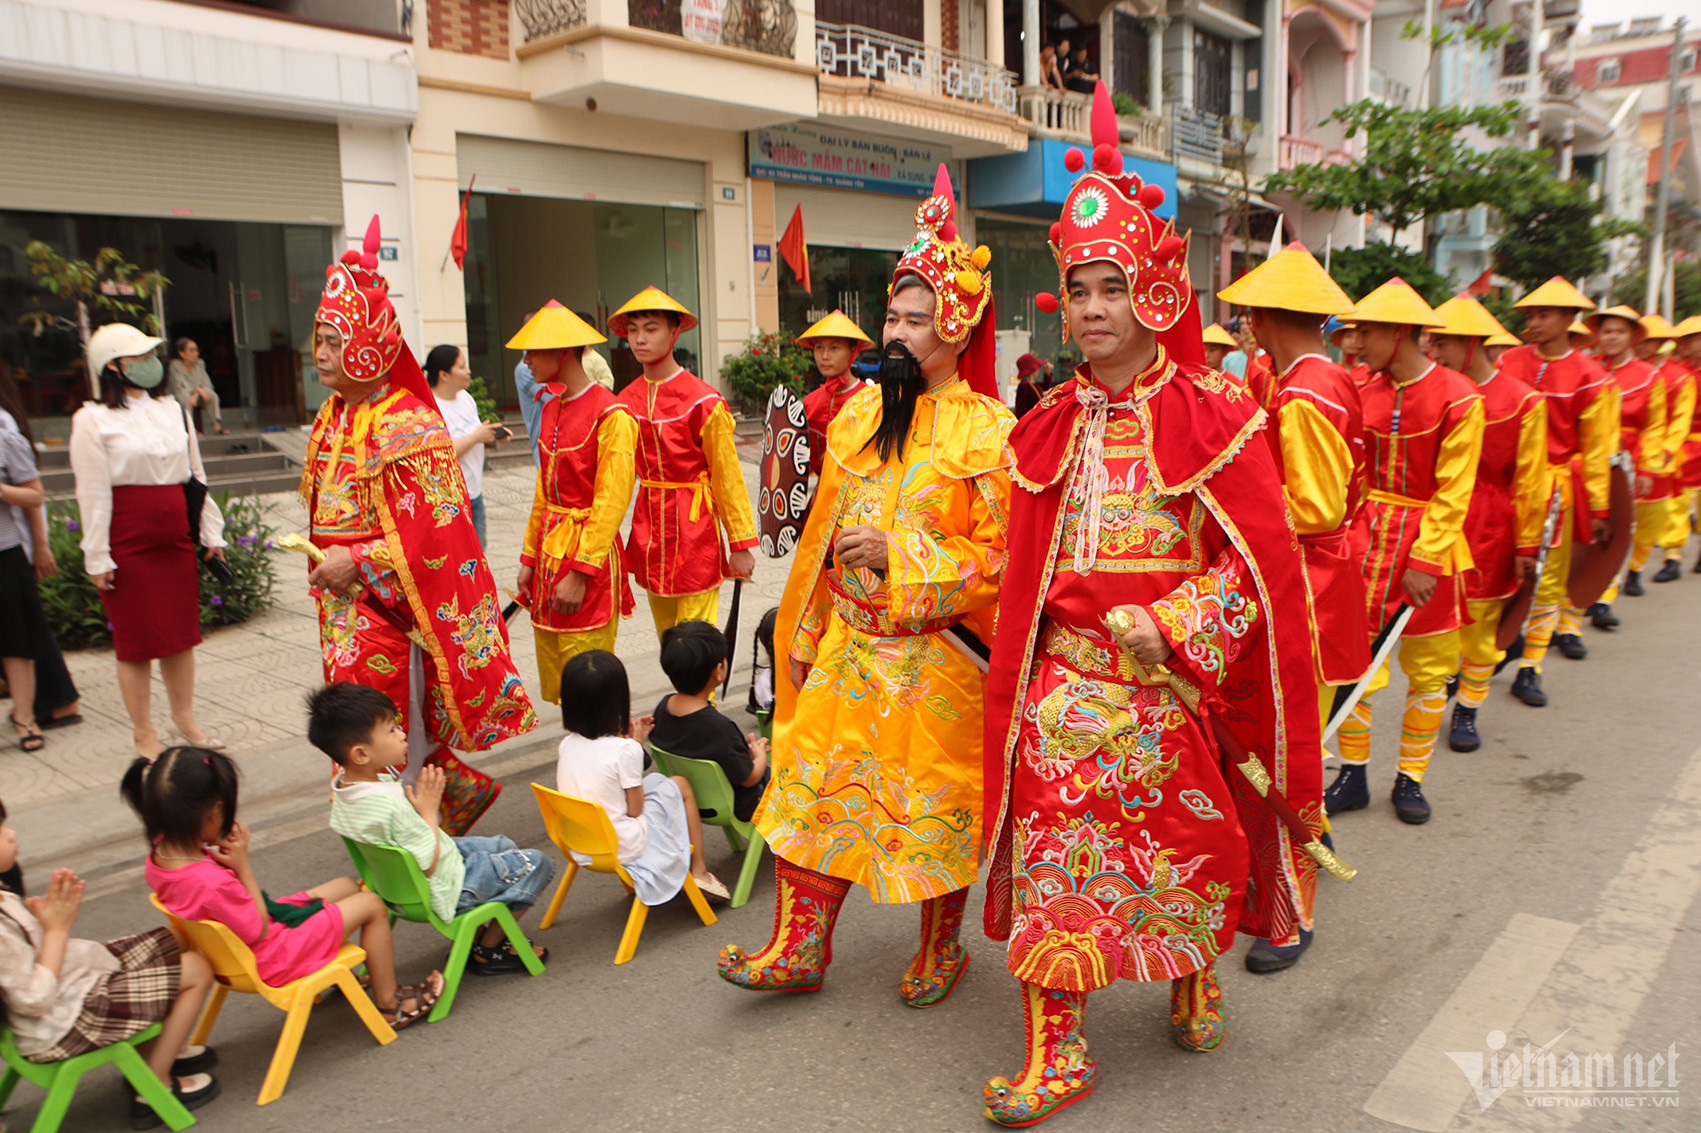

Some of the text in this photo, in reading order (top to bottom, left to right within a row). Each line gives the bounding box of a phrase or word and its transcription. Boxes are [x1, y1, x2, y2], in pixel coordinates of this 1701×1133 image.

[772, 144, 808, 168] NƯỚC
[846, 155, 868, 177] CÁT
[871, 155, 891, 179] HẢI
